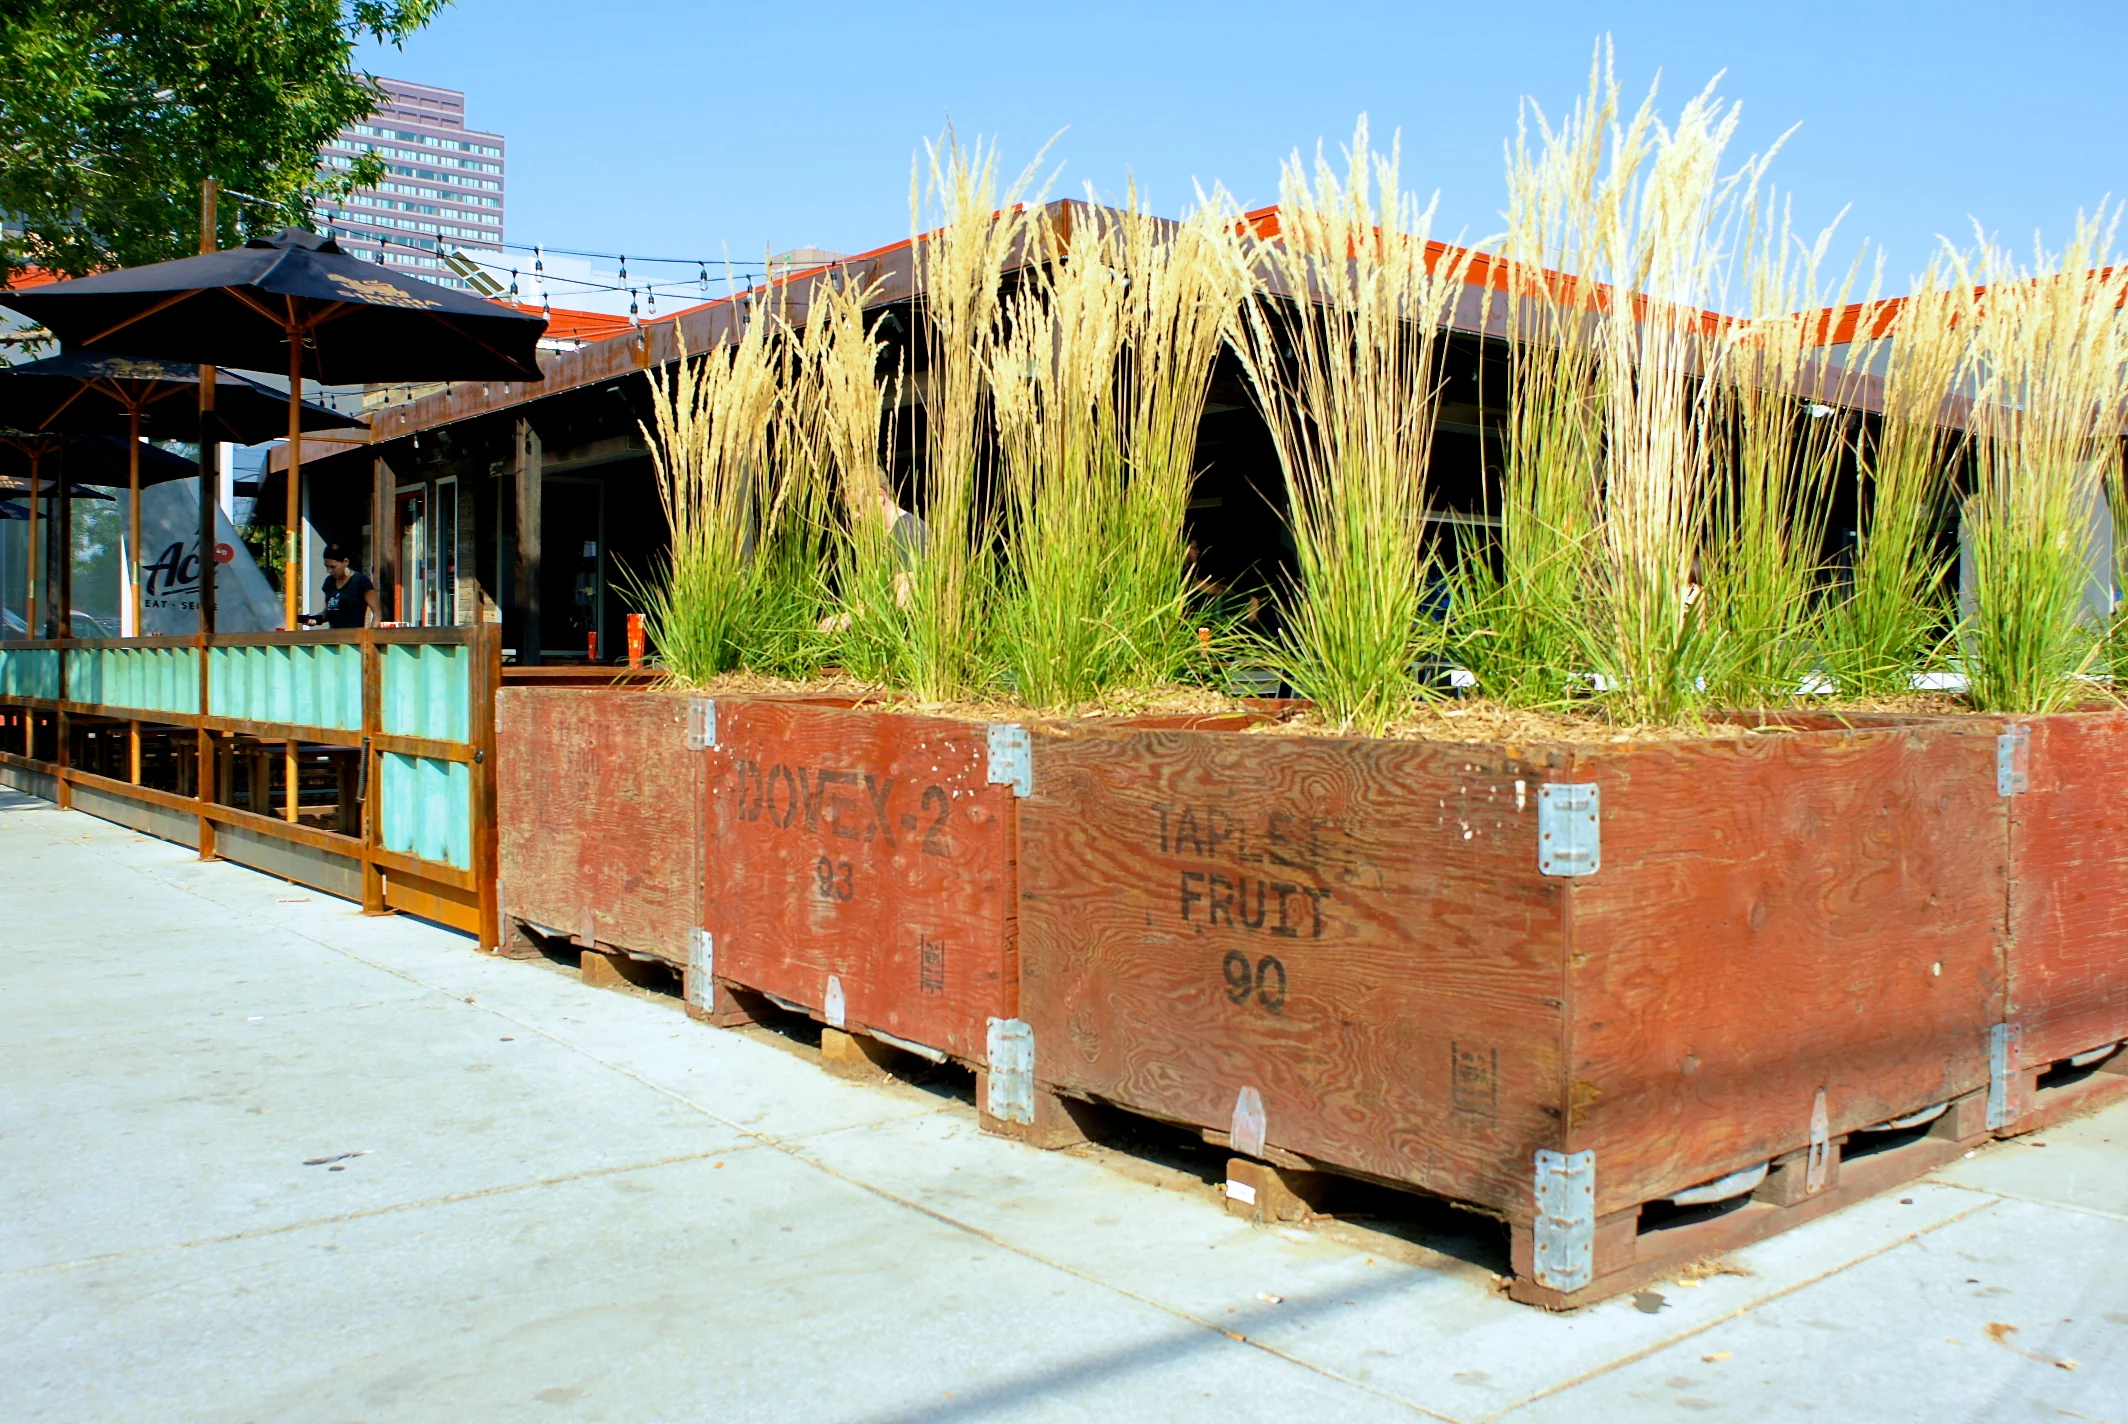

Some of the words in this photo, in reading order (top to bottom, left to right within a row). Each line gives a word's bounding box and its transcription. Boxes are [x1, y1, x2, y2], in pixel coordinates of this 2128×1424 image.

[142, 541, 218, 596] Ac
[145, 600, 167, 608] EAT
[1180, 869, 1331, 939] FRUIT
[1222, 949, 1287, 1015] 90
